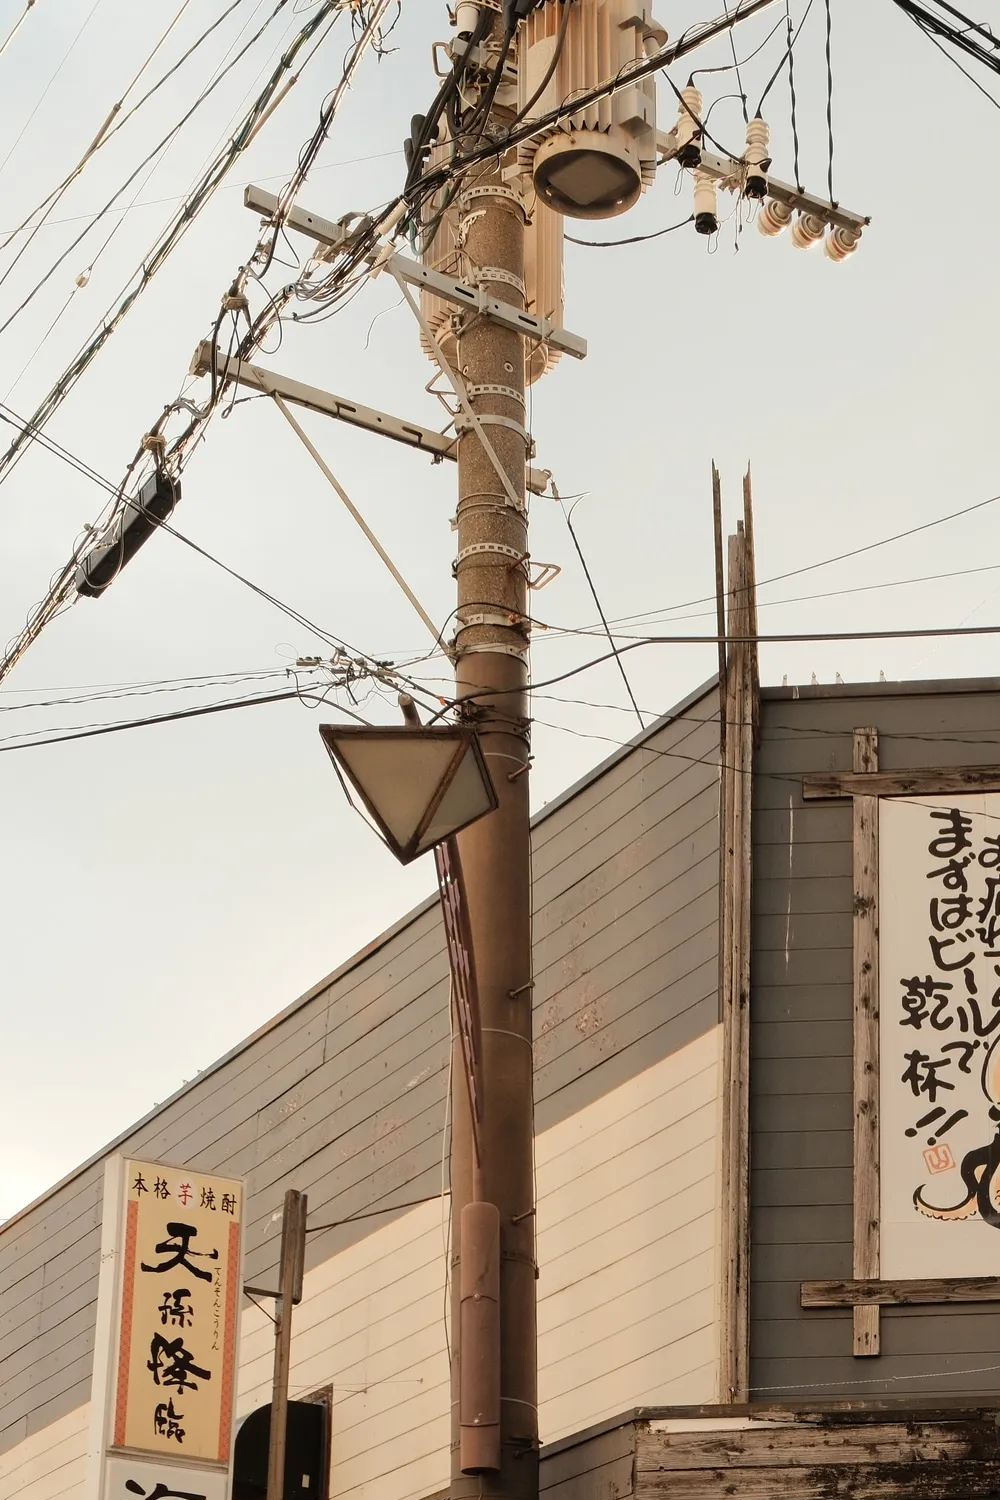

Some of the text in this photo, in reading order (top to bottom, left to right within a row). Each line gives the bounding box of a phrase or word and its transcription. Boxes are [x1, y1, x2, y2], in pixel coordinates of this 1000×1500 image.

[131, 1172, 237, 1216] 本格芋焼酎
[140, 1221, 219, 1443] 天孫降臨
[211, 1267, 222, 1351] てんそんこうりん
